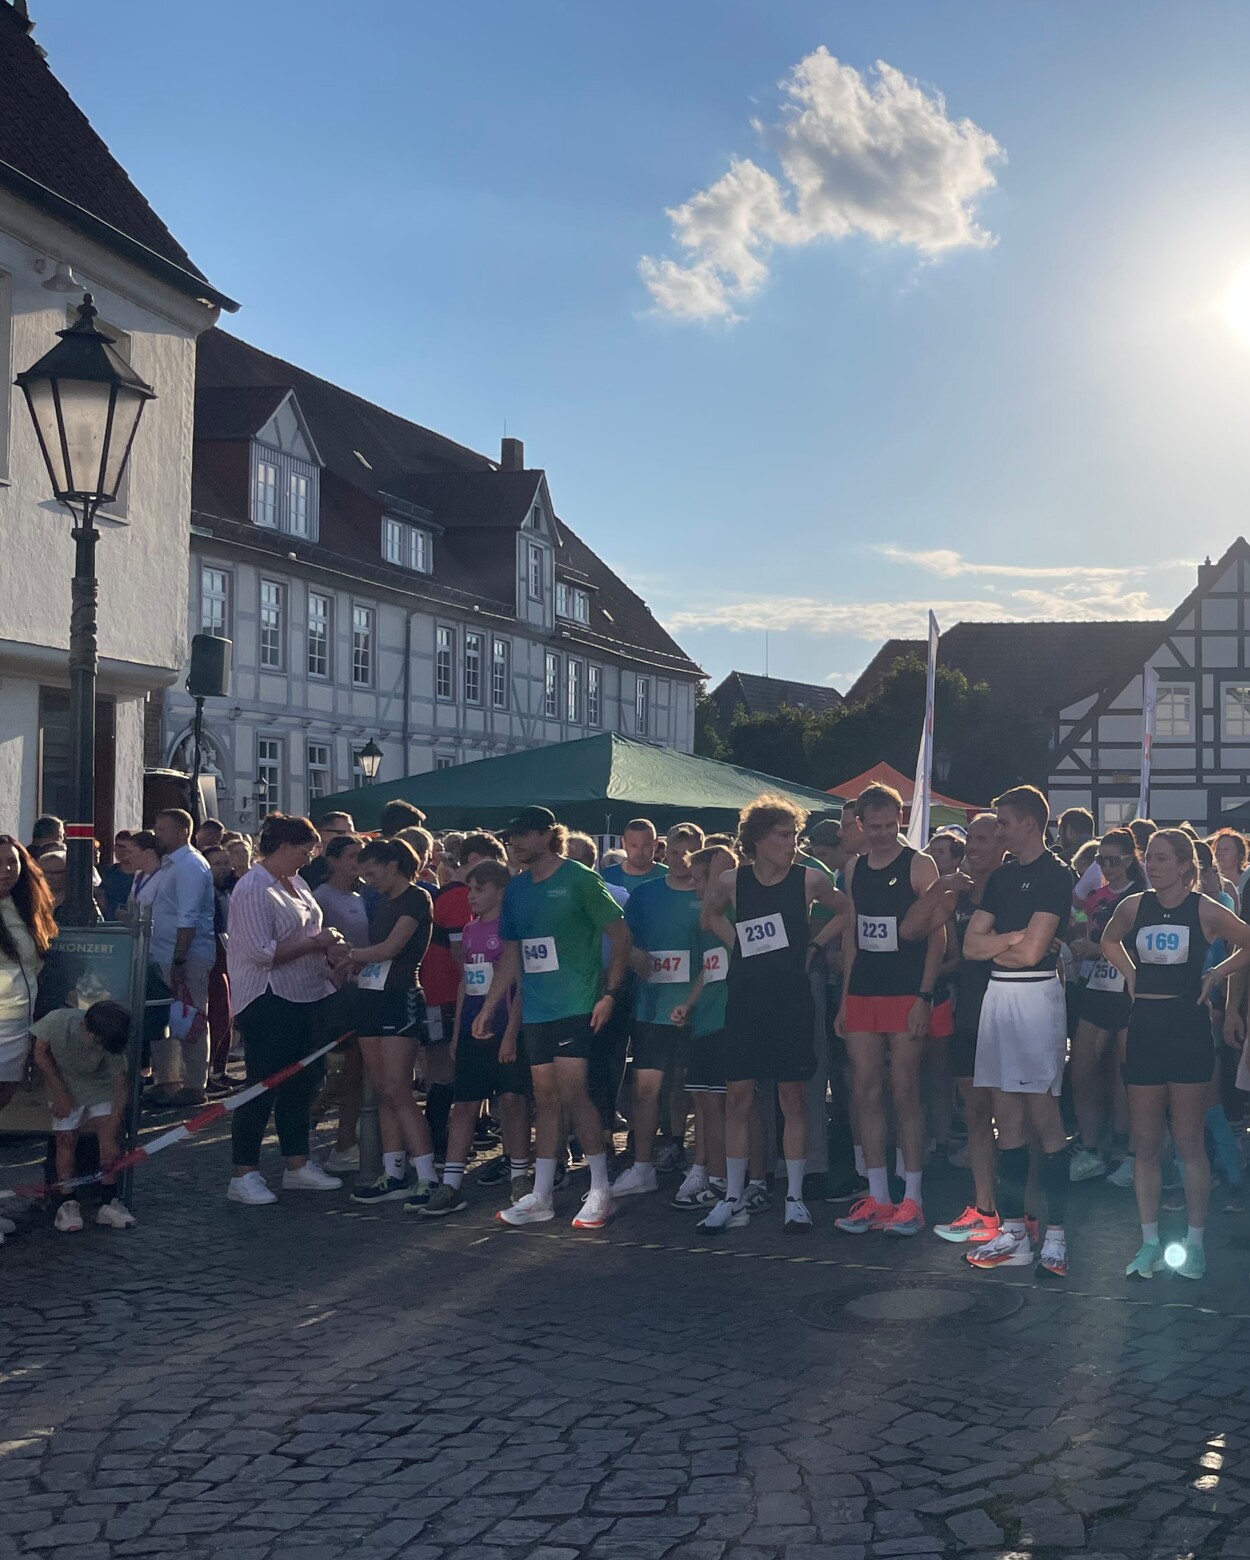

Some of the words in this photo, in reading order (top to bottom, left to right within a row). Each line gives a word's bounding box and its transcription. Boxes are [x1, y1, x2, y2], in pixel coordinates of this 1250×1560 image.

[745, 921, 776, 943] 230
[862, 920, 888, 939] 223
[1145, 933, 1180, 951] 169
[654, 957, 682, 972] 647
[702, 955, 721, 971] 42
[1094, 965, 1118, 980] 250
